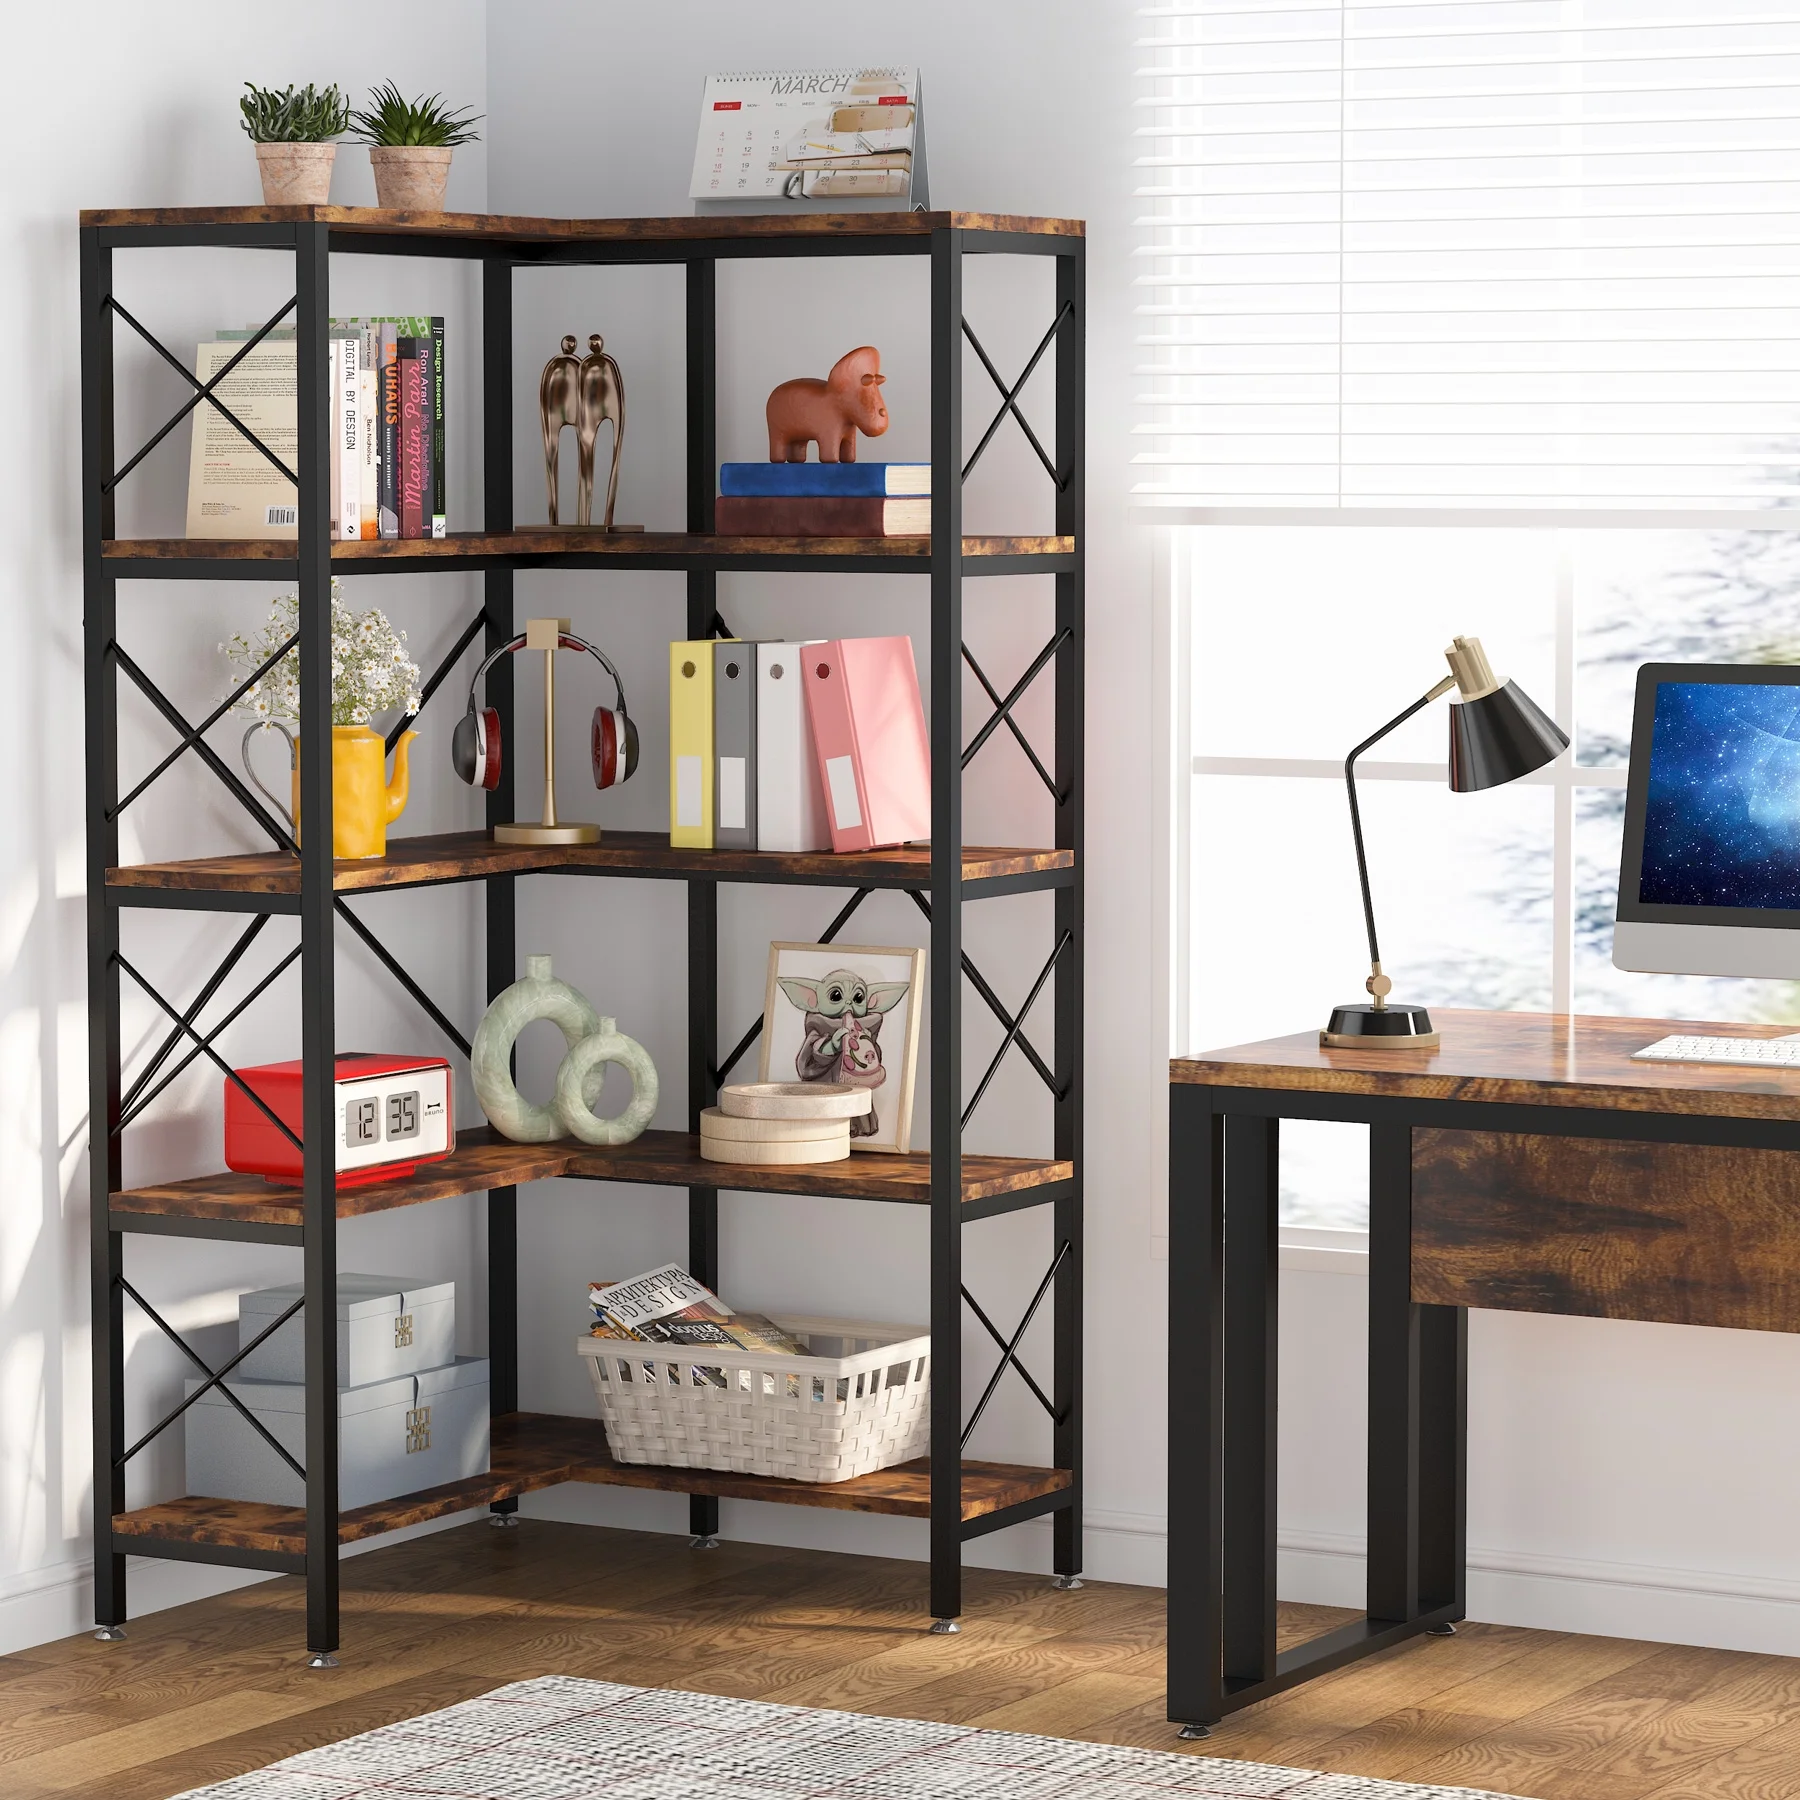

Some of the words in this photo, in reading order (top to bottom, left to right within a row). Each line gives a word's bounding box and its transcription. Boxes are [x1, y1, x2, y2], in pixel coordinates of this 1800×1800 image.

[770, 77, 850, 95] MARCH
[345, 340, 355, 383] DIGITAL
[420, 349, 429, 373] Ron
[434, 339, 443, 373] Design
[346, 390, 356, 403] BY
[385, 343, 398, 425] BAUHAUS
[404, 362, 421, 419] Parr
[420, 376, 429, 406] Arad
[435, 374, 443, 420] Research
[346, 410, 356, 450] DESIGN
[421, 413, 430, 431] No
[405, 425, 420, 505] Martin
[421, 434, 430, 491] Discipline
[359, 1103, 375, 1139] 12
[390, 1096, 415, 1134] 35
[424, 1109, 444, 1117] BRUNO
[603, 1268, 690, 1307] АРХИТЕКТУРА
[622, 1279, 702, 1318] DESIGN
[667, 1322, 720, 1334] domus
